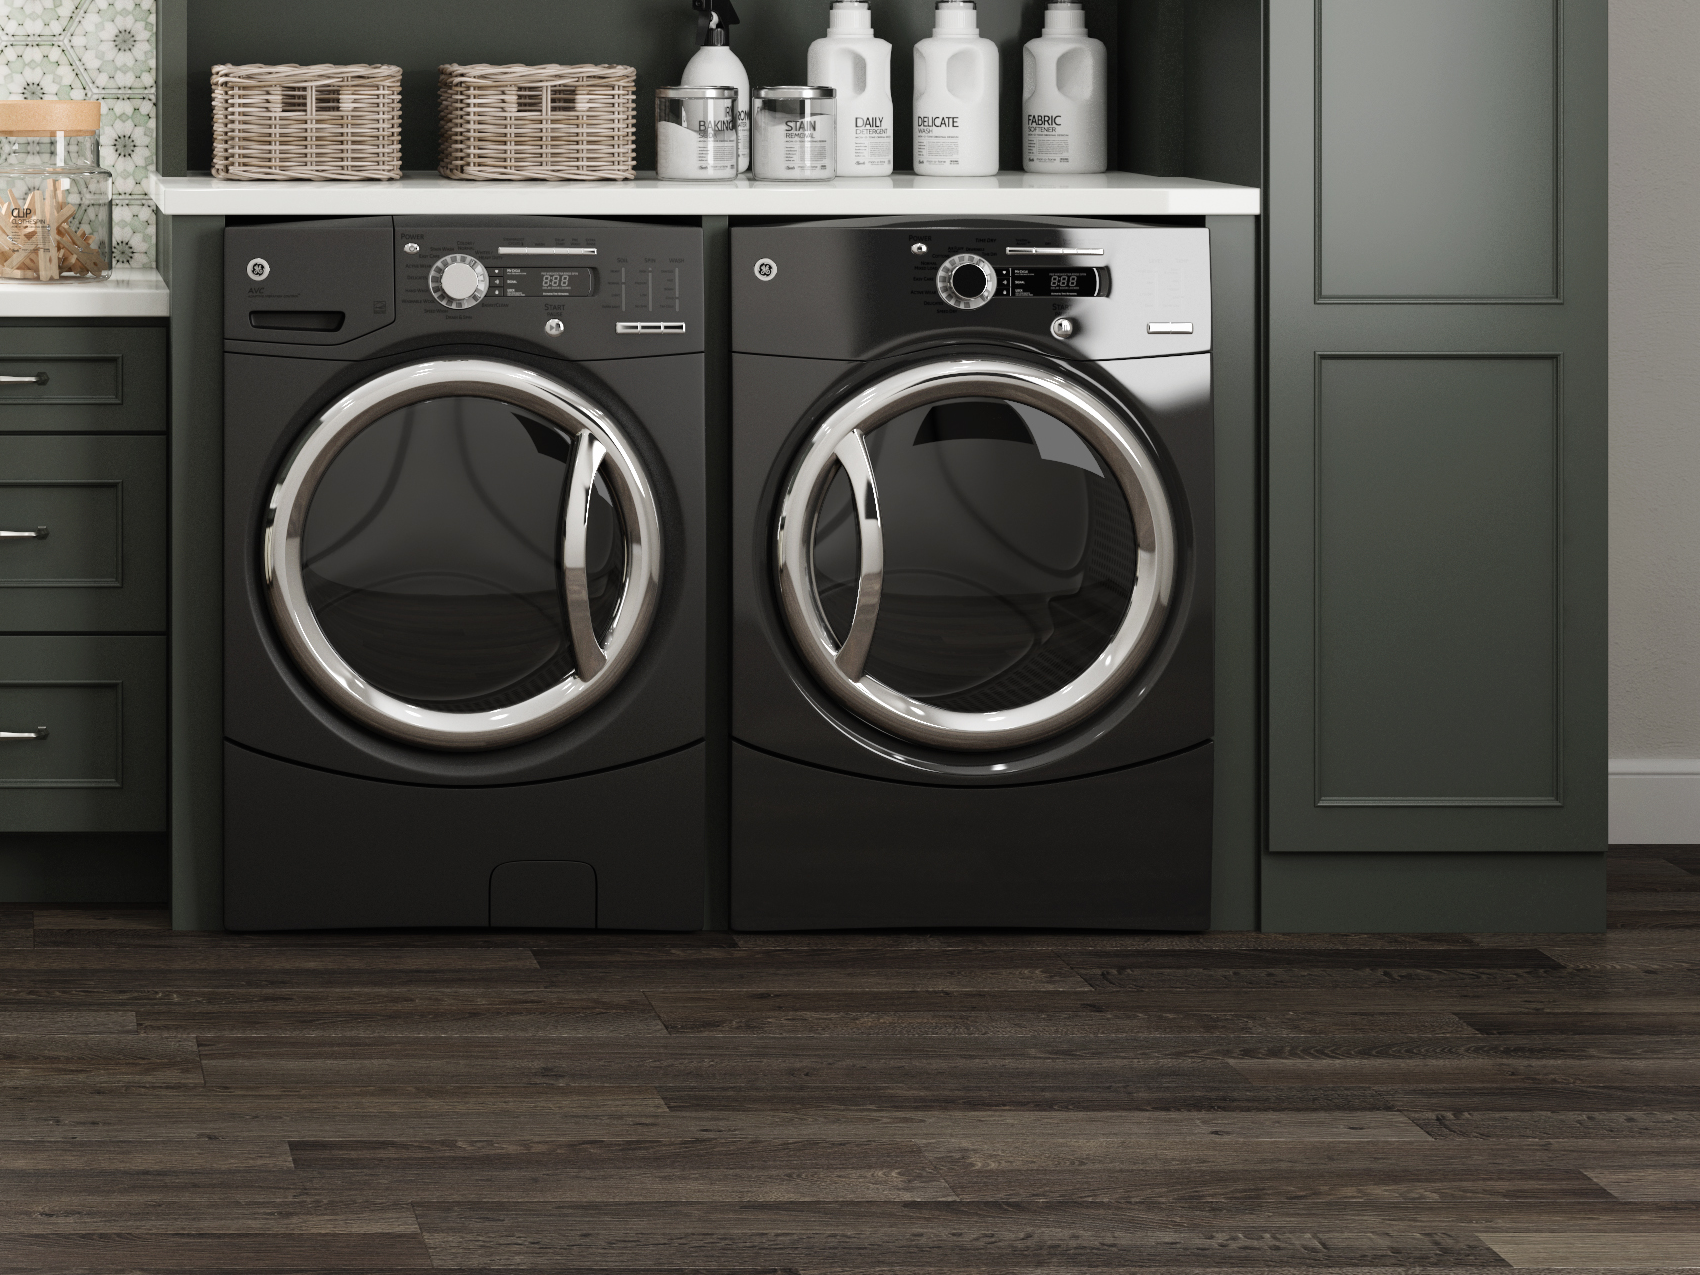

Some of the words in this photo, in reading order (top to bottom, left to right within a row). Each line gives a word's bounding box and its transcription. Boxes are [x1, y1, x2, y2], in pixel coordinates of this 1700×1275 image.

[698, 120, 734, 132] BAKING
[785, 120, 816, 132] STAIN
[855, 117, 884, 128] DAILY
[917, 116, 959, 128] DELICATE
[1027, 114, 1062, 126] FABRIC
[908, 234, 932, 242] POWER
[542, 275, 569, 287] 8:88
[1050, 276, 1078, 287] 8:88
[545, 303, 565, 311] START
